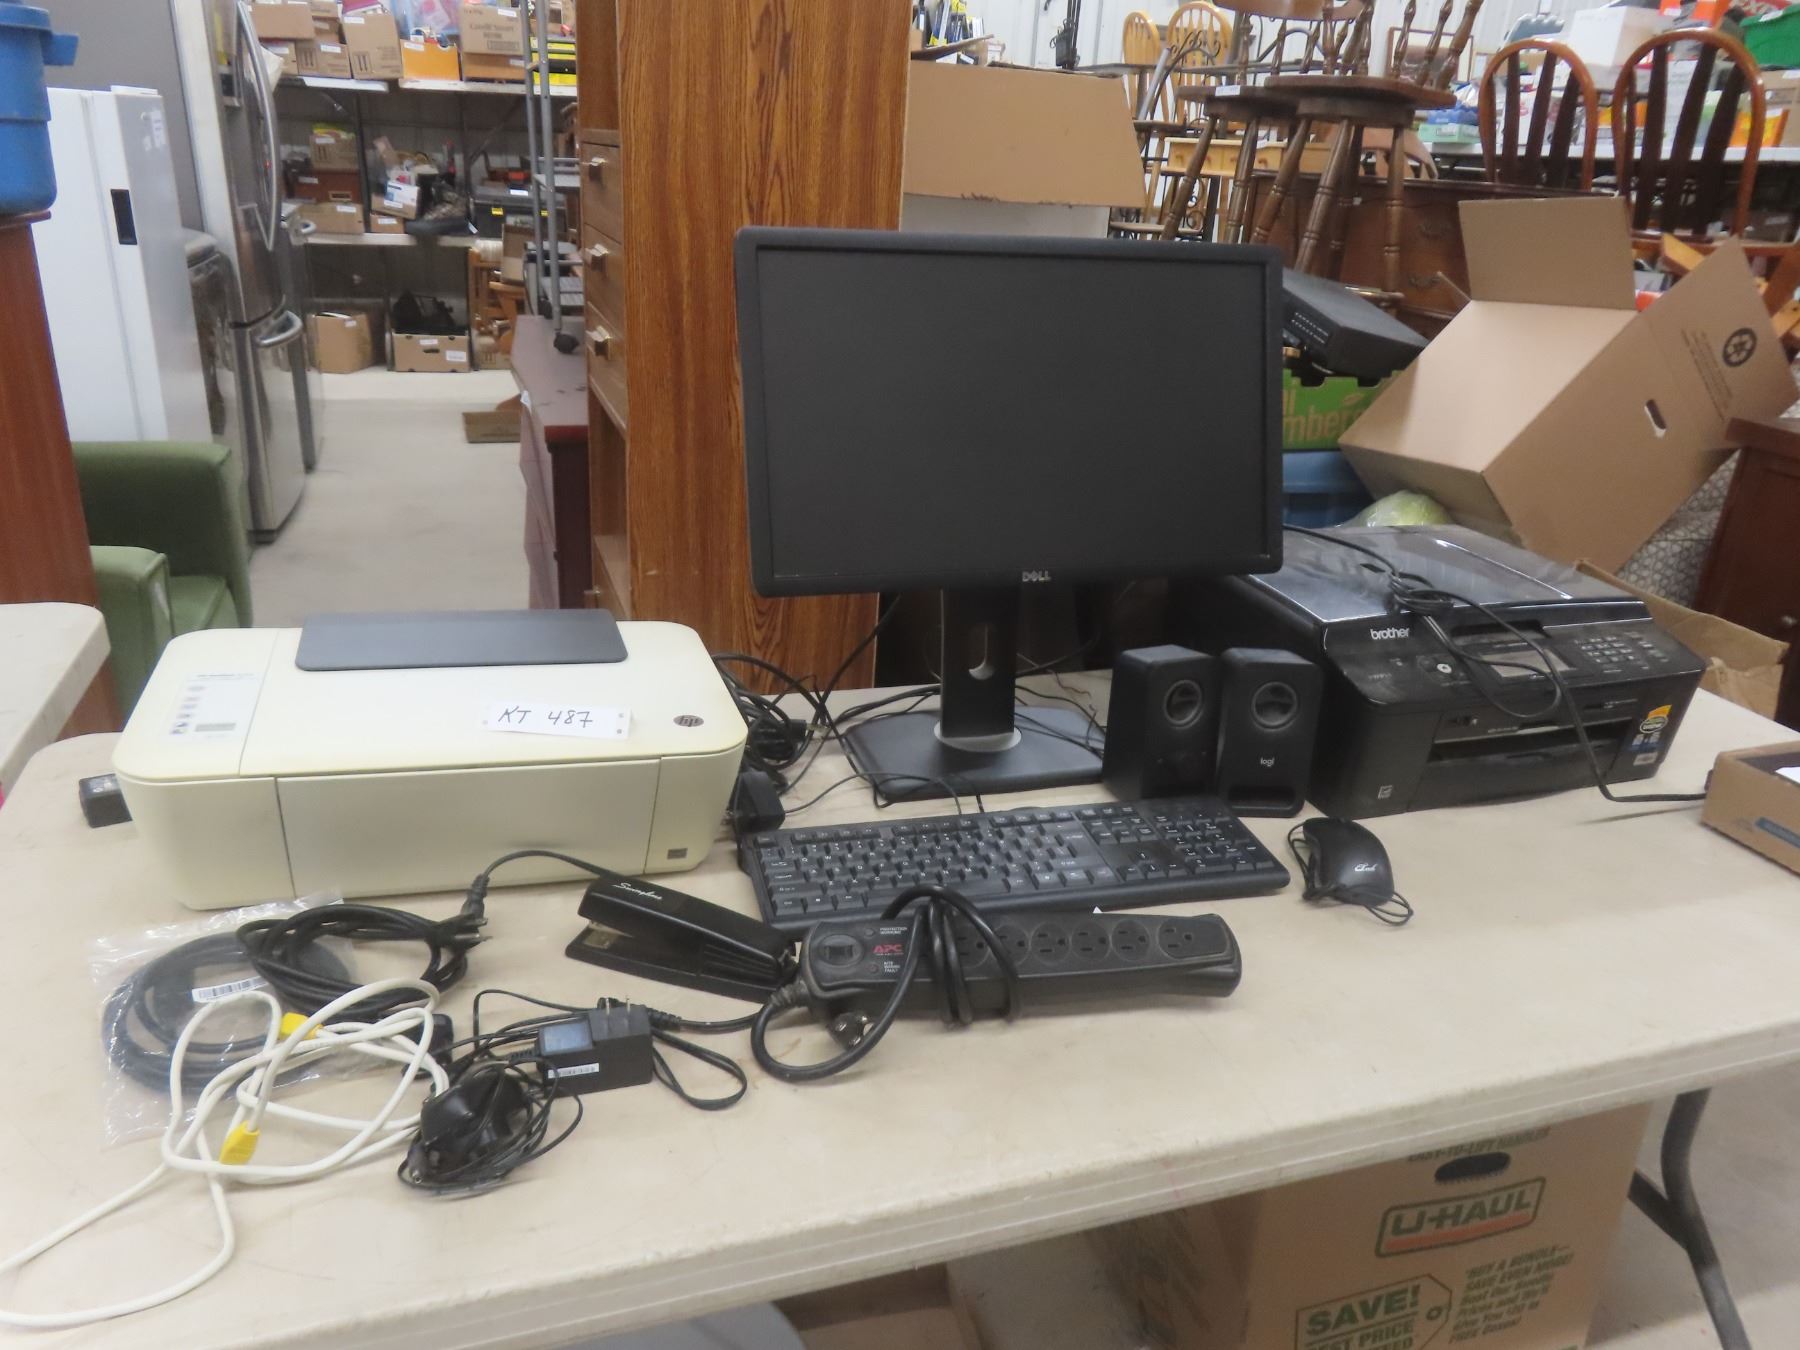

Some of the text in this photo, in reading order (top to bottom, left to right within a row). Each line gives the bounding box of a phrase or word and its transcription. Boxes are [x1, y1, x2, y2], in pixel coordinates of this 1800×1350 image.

[1022, 570, 1051, 581] DELL
[1370, 627, 1410, 640] brother
[498, 705, 593, 728] KT 487
[1260, 757, 1275, 767] logi
[873, 943, 904, 953] APC
[1391, 1188, 1531, 1236] U-HAUL
[1306, 1284, 1420, 1336] SAVE!
[1358, 1317, 1415, 1348] PRICE
